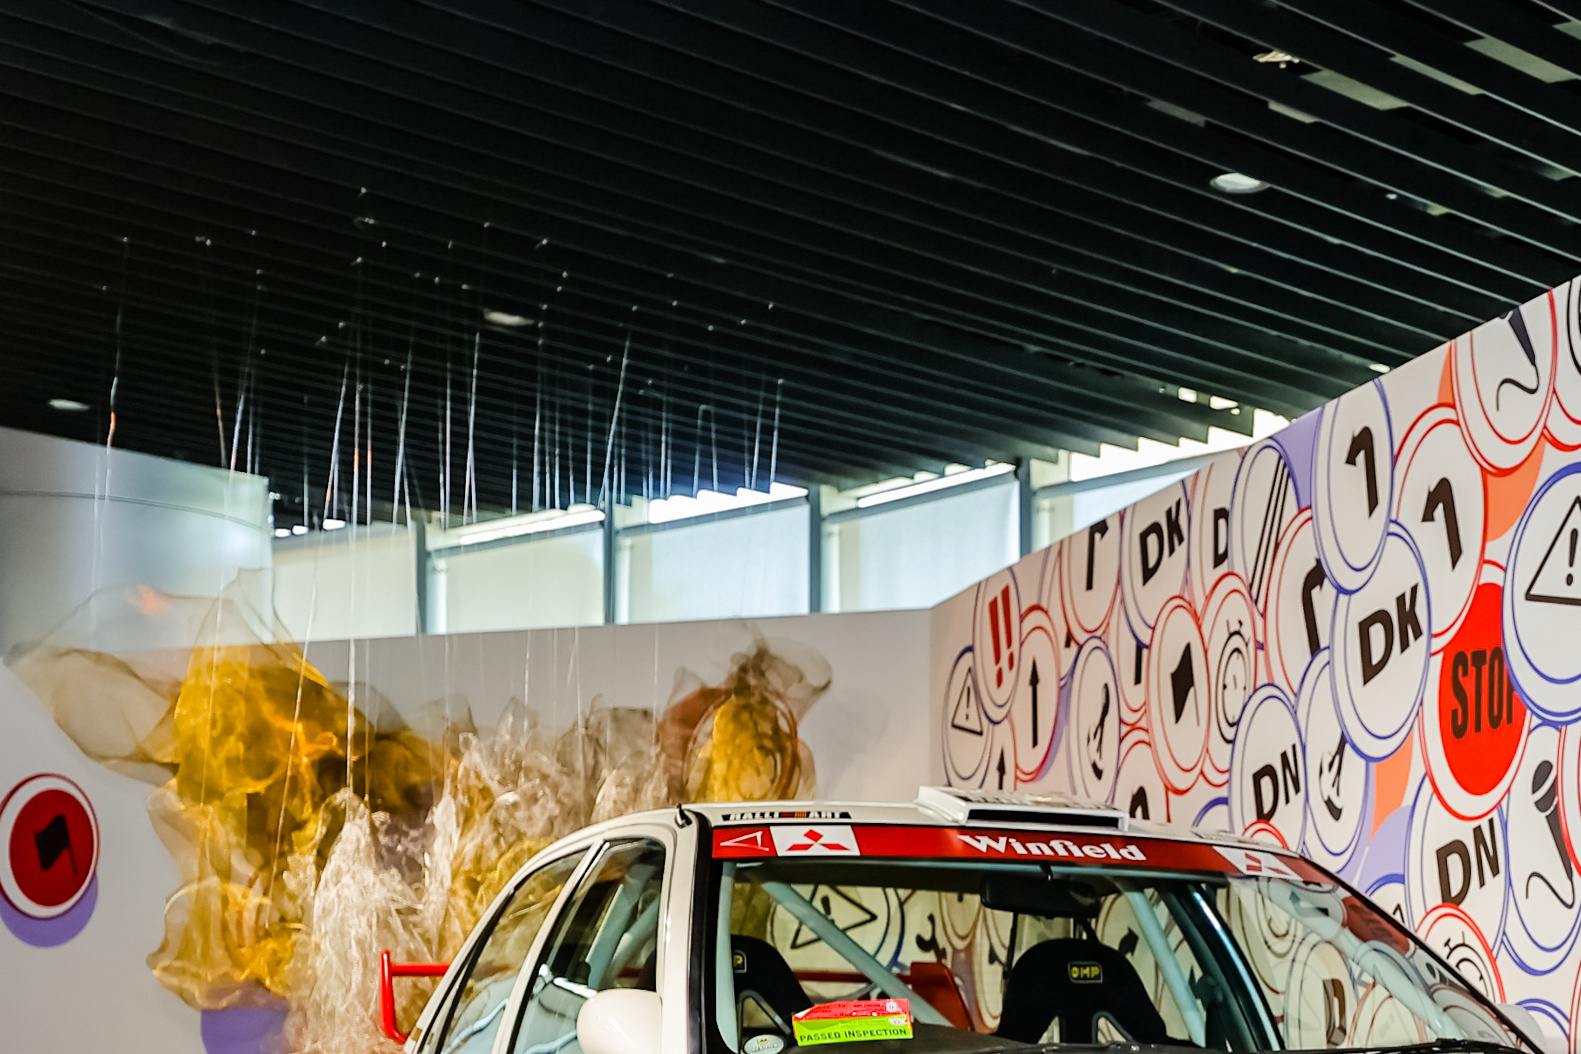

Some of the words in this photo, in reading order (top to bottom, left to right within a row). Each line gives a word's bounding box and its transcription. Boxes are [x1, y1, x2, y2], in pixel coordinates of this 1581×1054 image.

[1139, 497, 1184, 587] DK
[1358, 583, 1423, 686] DK
[1252, 743, 1301, 822] DN
[957, 834, 1147, 862] Winfield
[1436, 817, 1500, 907] DN
[1071, 966, 1100, 978] OMP
[799, 1031, 841, 1043] PASSED
[845, 1028, 907, 1040] INSPECTION
